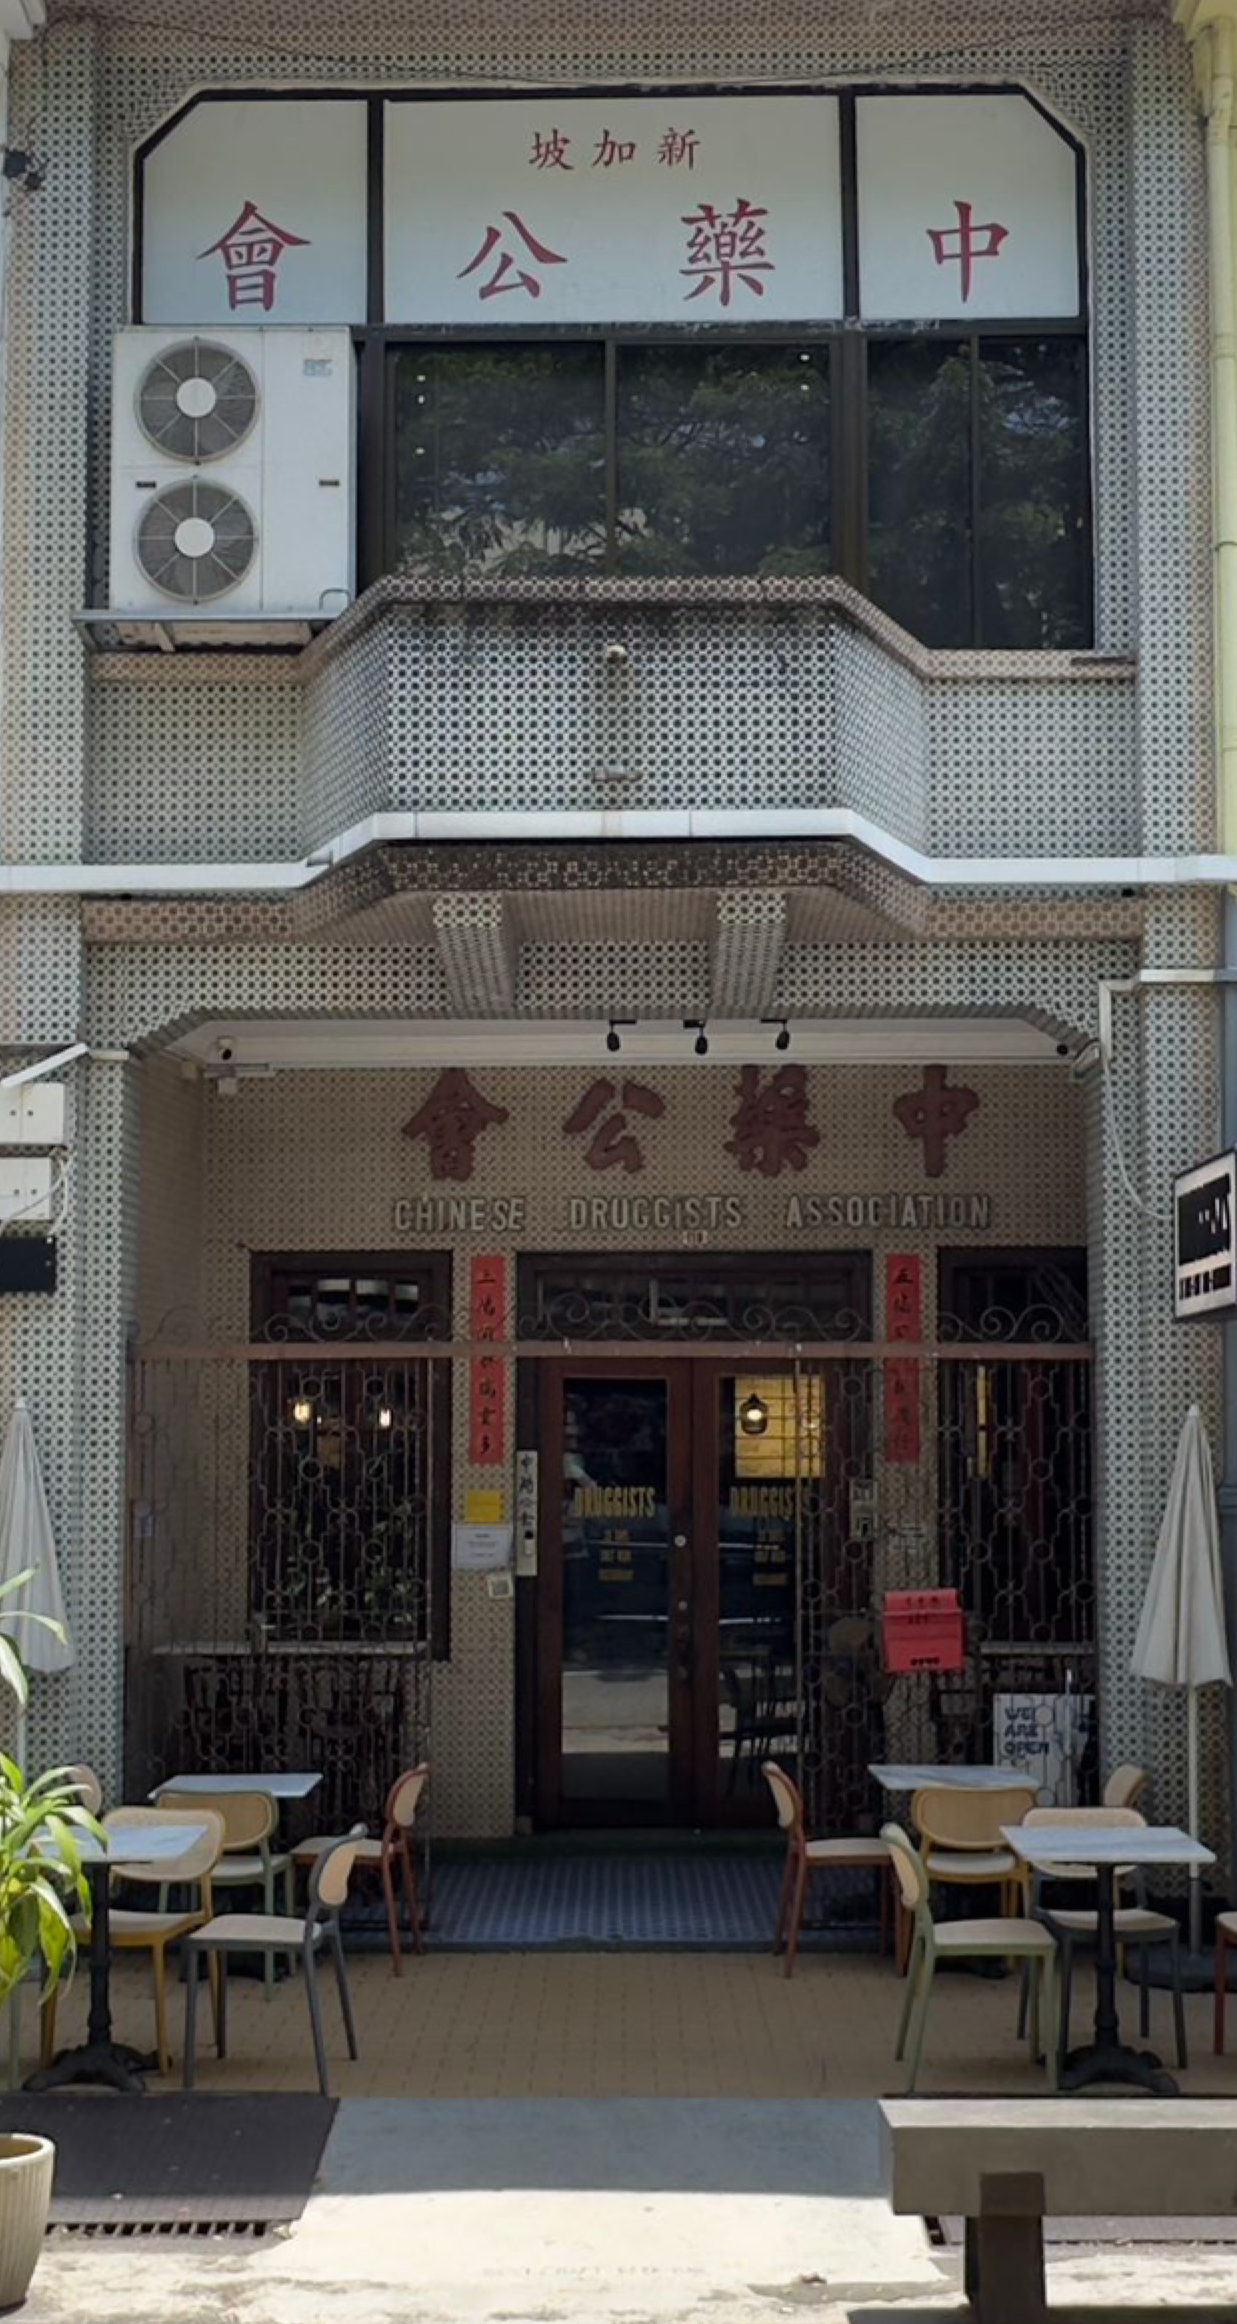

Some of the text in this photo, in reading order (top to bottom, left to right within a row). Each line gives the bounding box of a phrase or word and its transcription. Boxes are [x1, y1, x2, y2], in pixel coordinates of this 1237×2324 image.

[394, 1198, 992, 1230] CHINESE DRUGGISTS ASSOCIATION
[574, 1486, 656, 1519] DRUGGISTS
